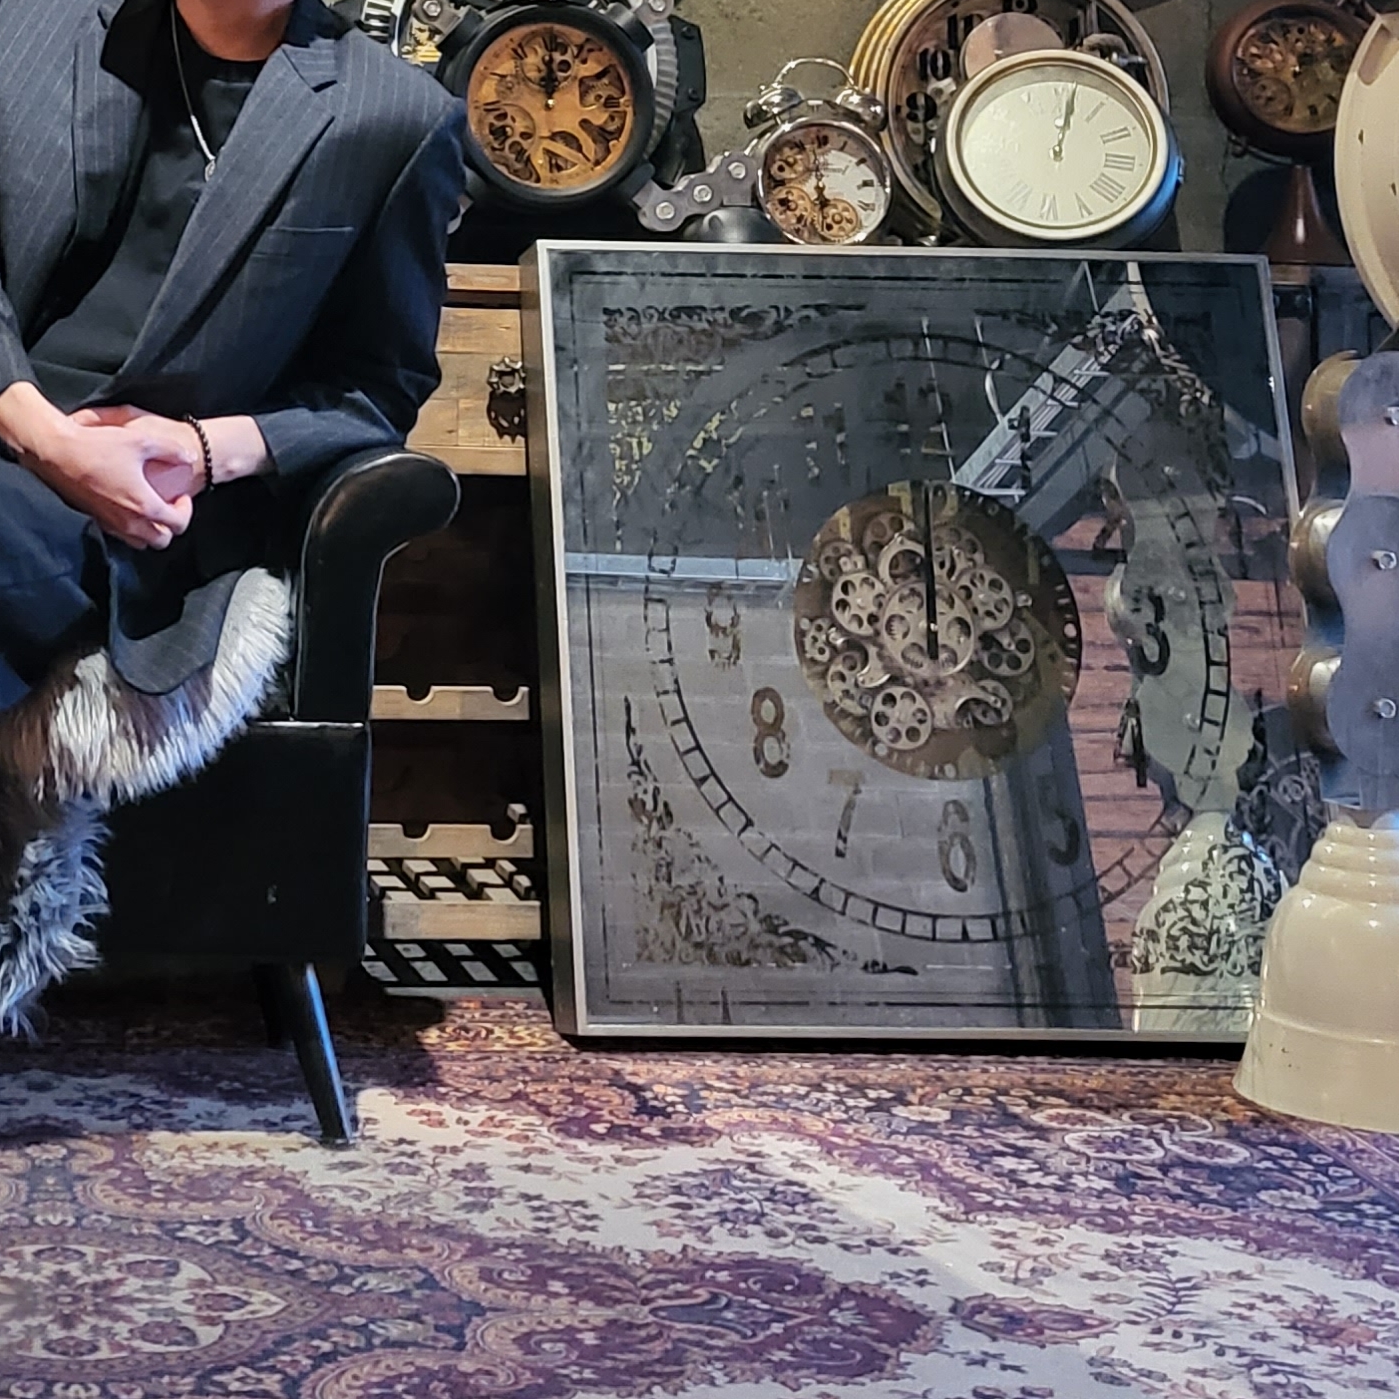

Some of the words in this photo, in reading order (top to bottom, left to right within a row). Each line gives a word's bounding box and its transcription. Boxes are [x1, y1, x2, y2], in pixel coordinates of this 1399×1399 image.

[751, 686, 790, 779] 8
[828, 768, 866, 858] 7
[937, 799, 977, 893] 6
